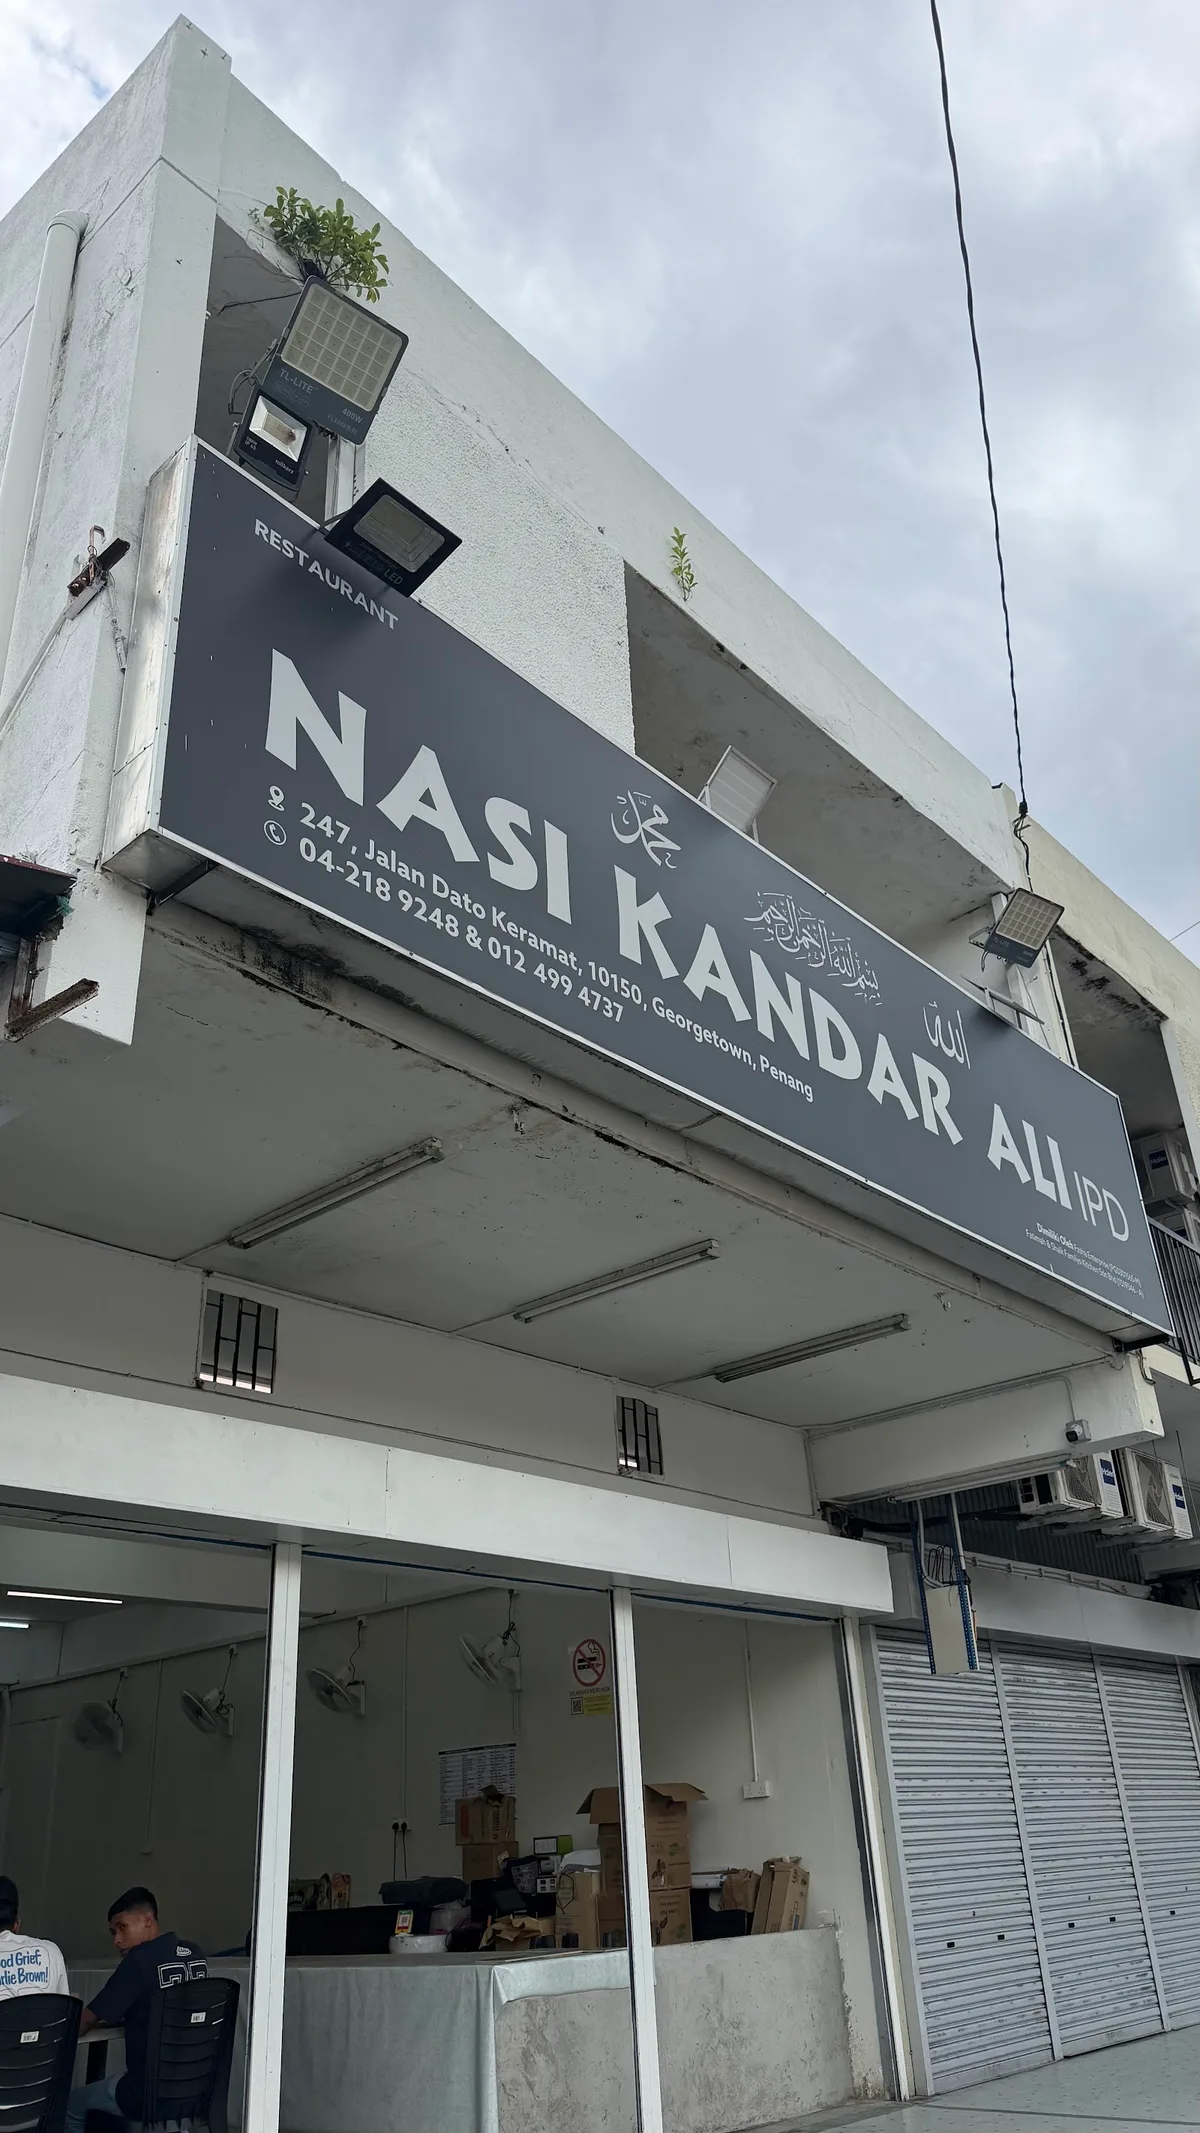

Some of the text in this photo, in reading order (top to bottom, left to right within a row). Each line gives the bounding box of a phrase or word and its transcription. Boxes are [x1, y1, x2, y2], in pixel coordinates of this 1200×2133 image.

[280, 368, 314, 395] TL-LITE
[342, 408, 363, 424] 400W
[255, 519, 398, 629] RESTAURANT
[384, 568, 404, 585] LED
[299, 837, 624, 1023] 04-218 9248 & 012 499 4737
[265, 648, 1130, 1243] NASI KANDAR ALI IPD
[364, 838, 425, 888] Jalan
[432, 873, 487, 920] Dato
[492, 905, 583, 977] Keramat,
[588, 960, 647, 1011] 10150,
[652, 996, 758, 1071] Georgetown,
[759, 1054, 814, 1103] Penang
[0, 1949, 42, 1968] od Grief,
[0, 1966, 49, 1986] rlie Brown!
